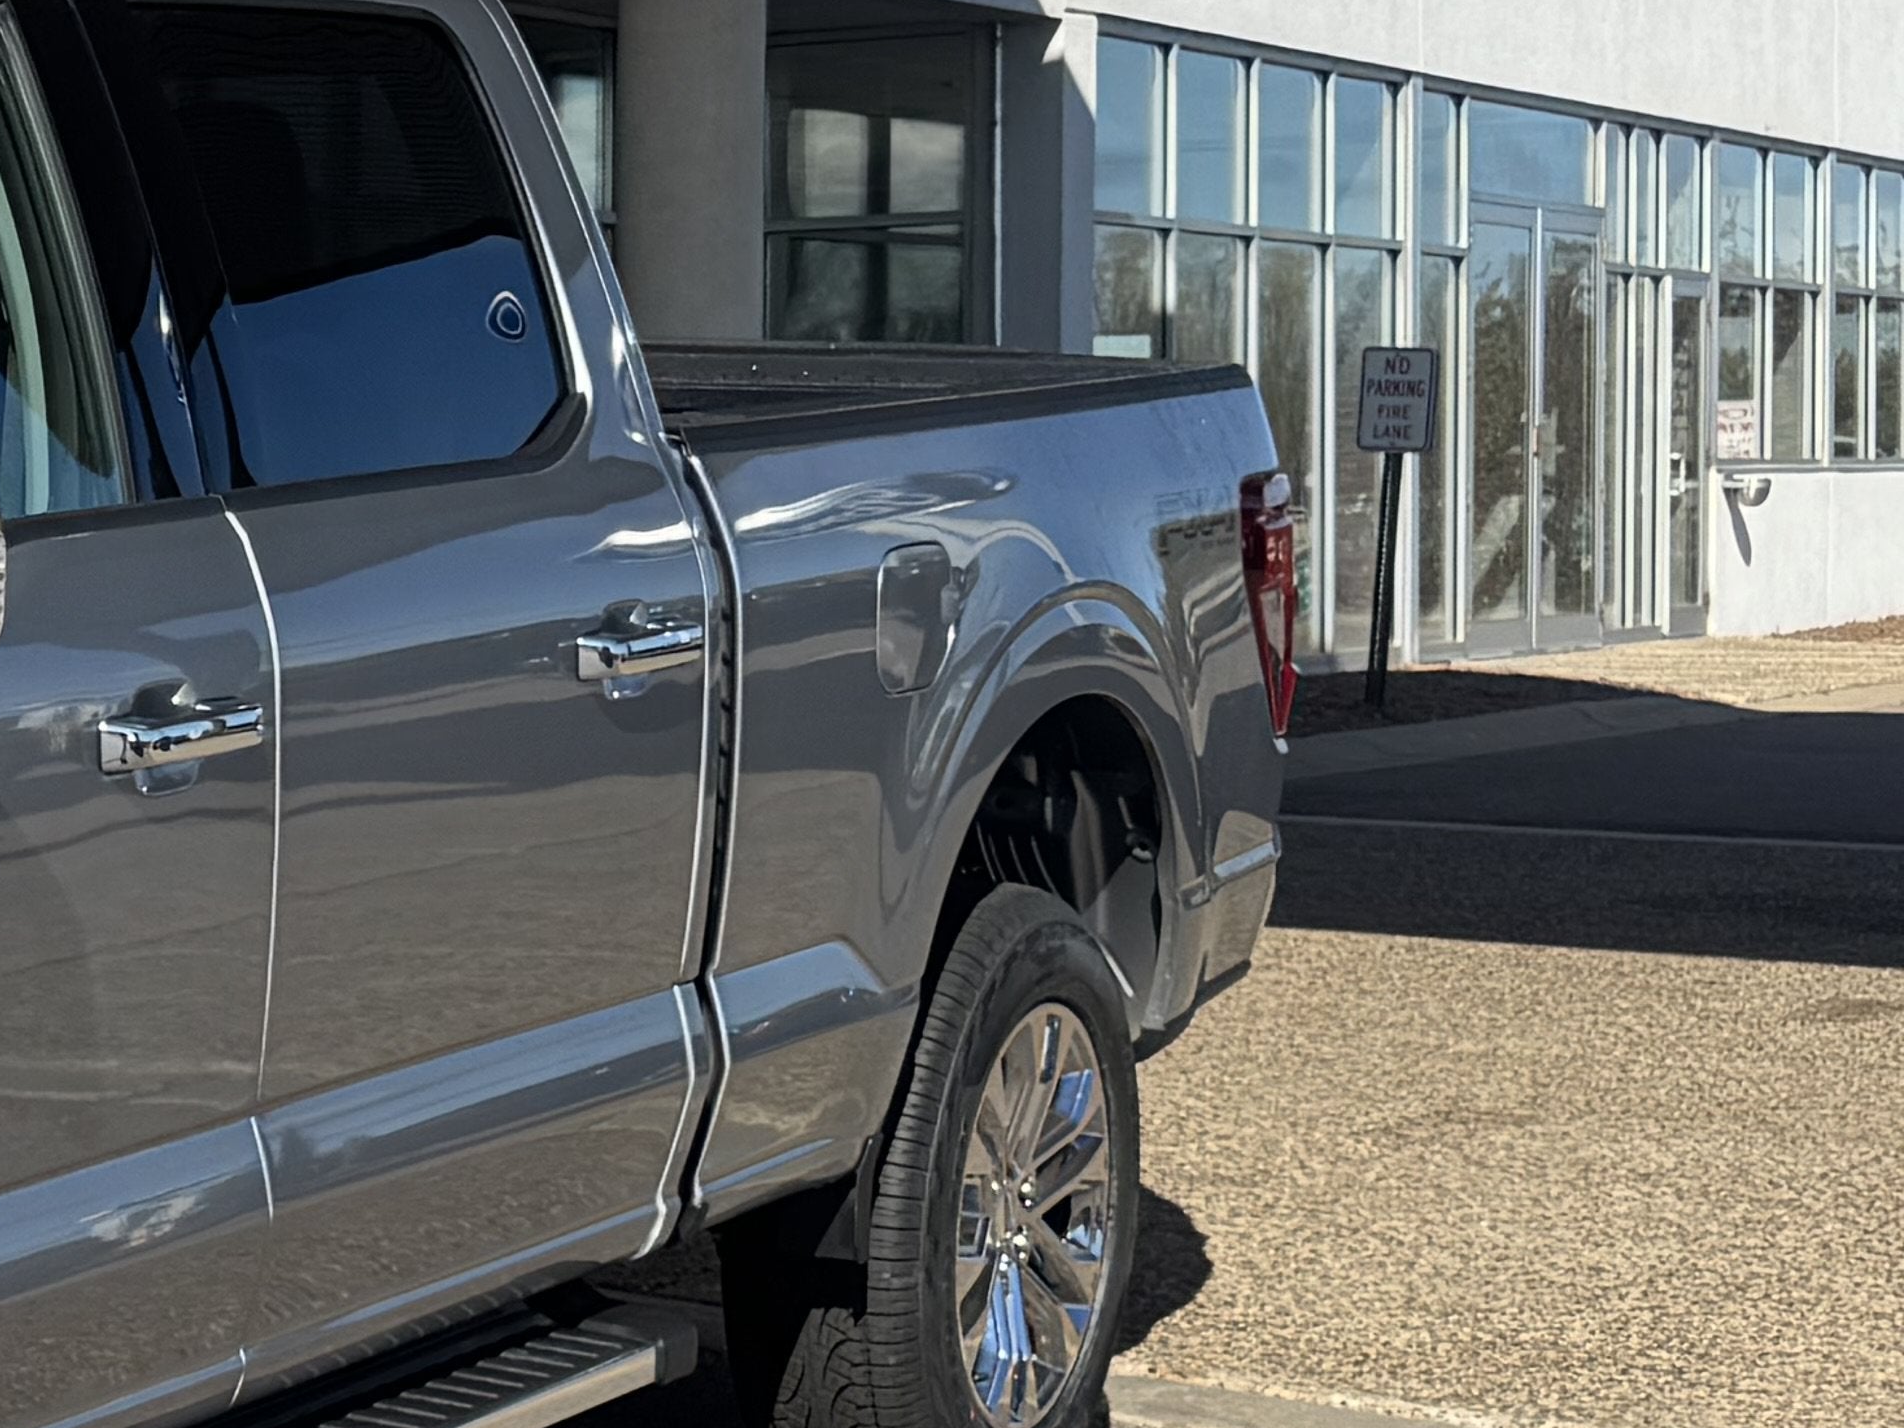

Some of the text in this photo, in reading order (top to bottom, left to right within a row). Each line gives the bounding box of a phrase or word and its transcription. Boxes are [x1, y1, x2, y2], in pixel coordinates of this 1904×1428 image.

[1384, 356, 1411, 375] NO
[1366, 378, 1426, 398] PARKING
[1377, 404, 1412, 421] FIRE
[1372, 424, 1414, 441] LANE
